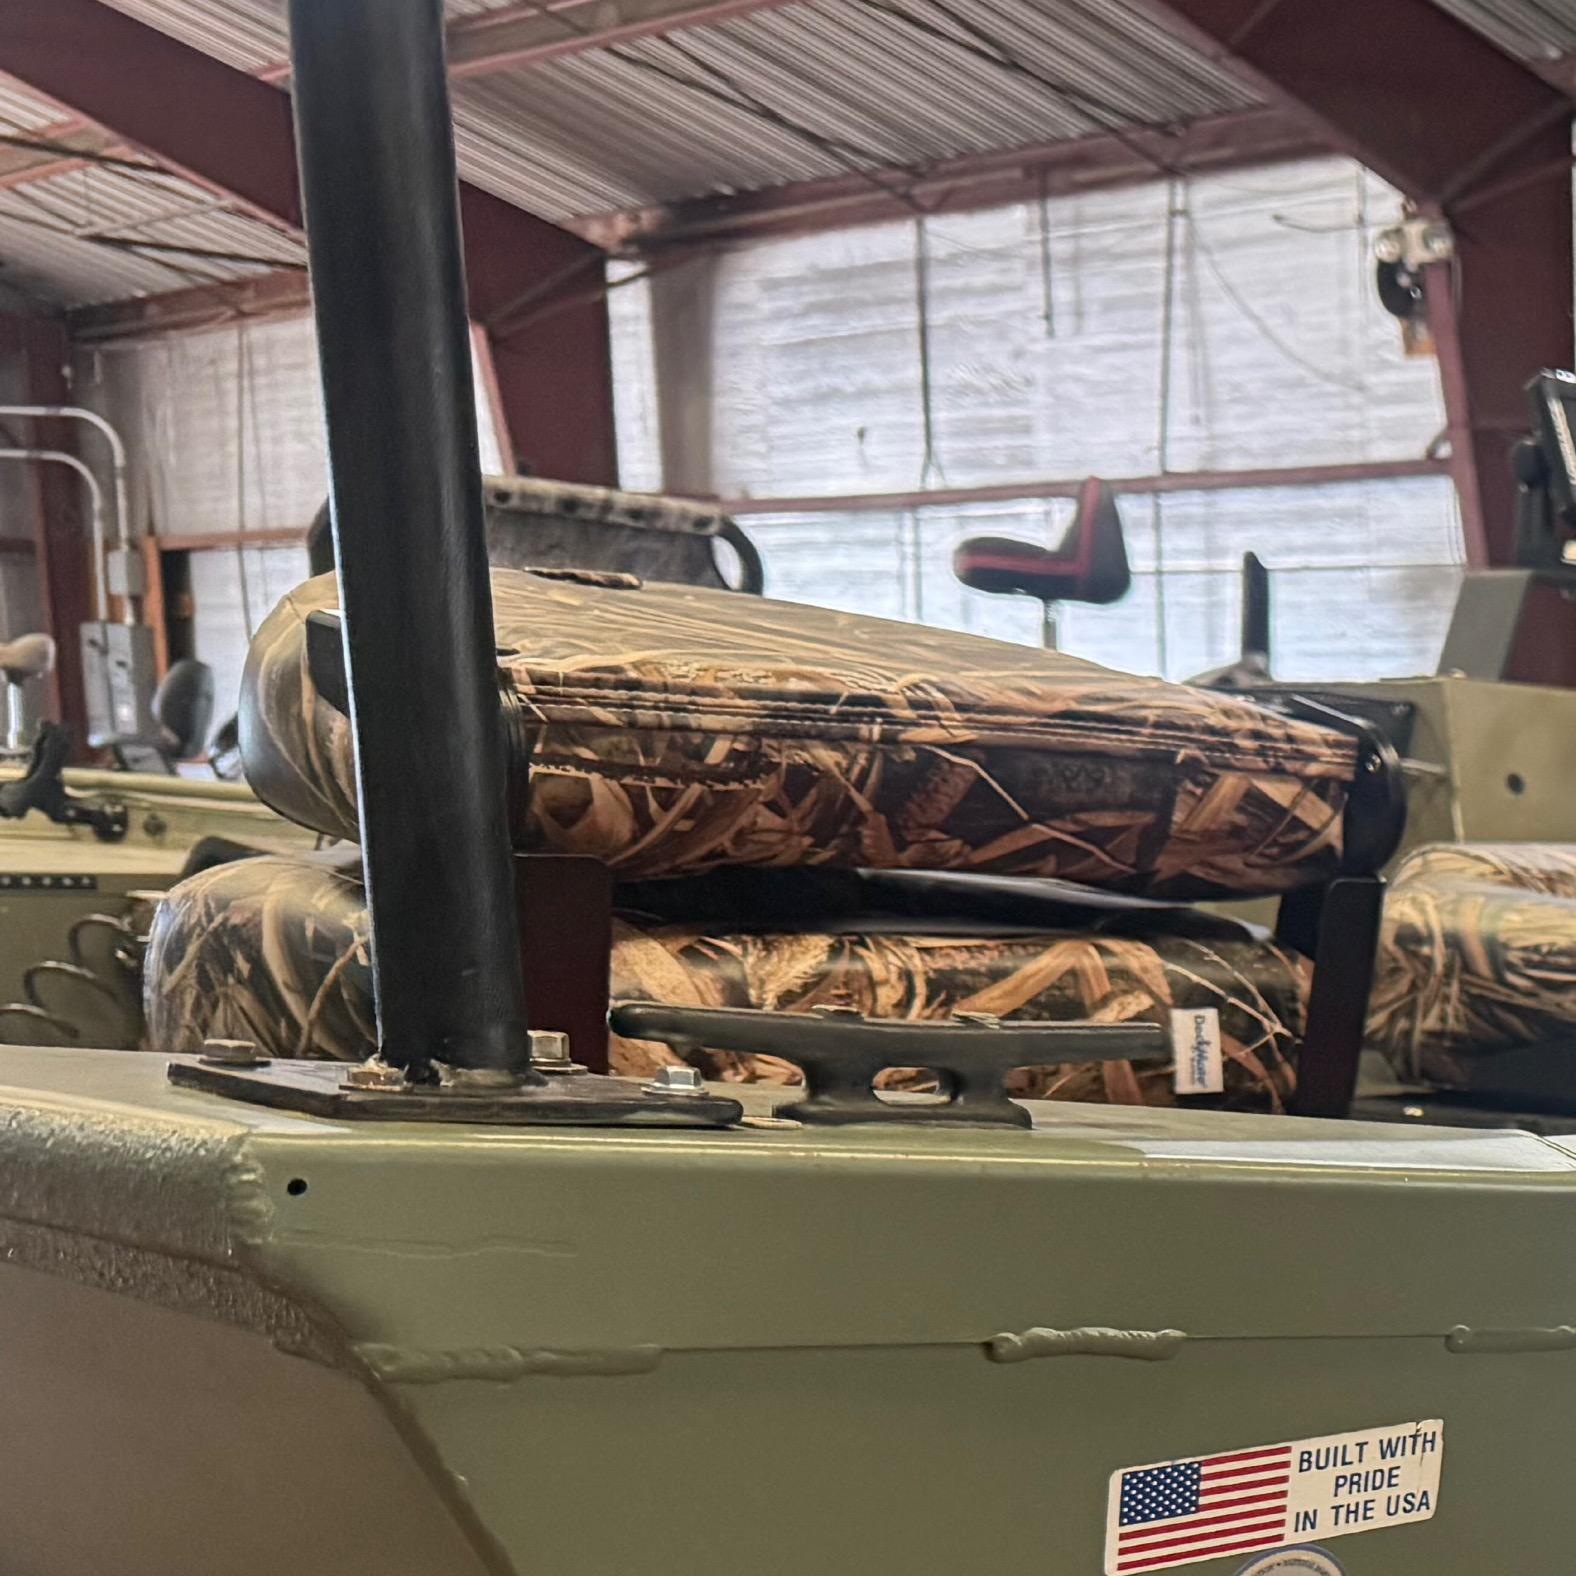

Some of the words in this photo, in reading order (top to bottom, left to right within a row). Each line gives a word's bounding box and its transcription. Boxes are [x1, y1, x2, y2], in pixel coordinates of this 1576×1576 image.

[1298, 1441, 1369, 1473] BUILT
[1379, 1431, 1437, 1460] WITH
[1333, 1466, 1401, 1497] PRIDE
[1294, 1509, 1318, 1533] IN
[1331, 1499, 1376, 1526] THE
[1386, 1490, 1431, 1517] USA
